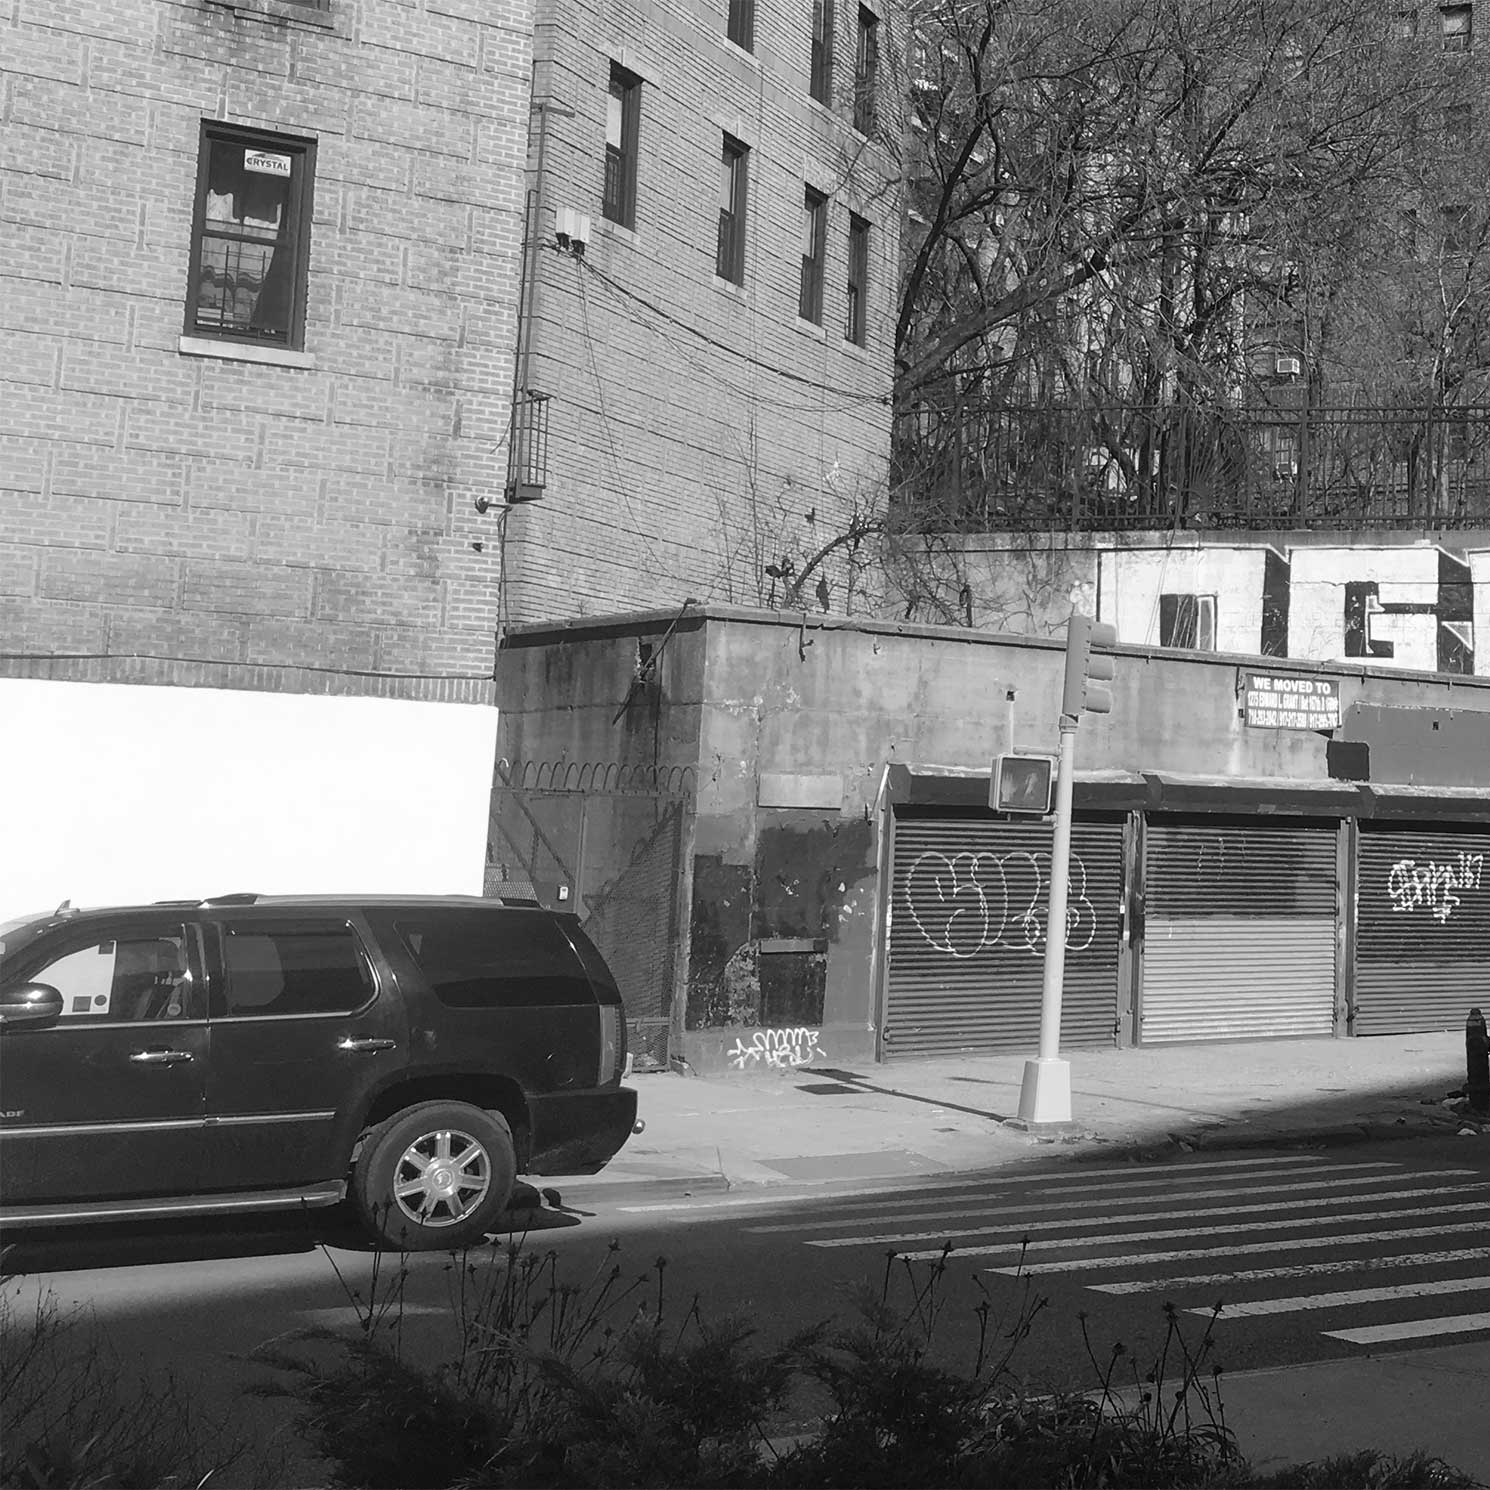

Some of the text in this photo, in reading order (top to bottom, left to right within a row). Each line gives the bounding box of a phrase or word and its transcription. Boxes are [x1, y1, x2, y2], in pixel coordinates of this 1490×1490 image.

[246, 157, 289, 171] CRYSTAL
[1253, 676, 1331, 695] WE MOVED TO
